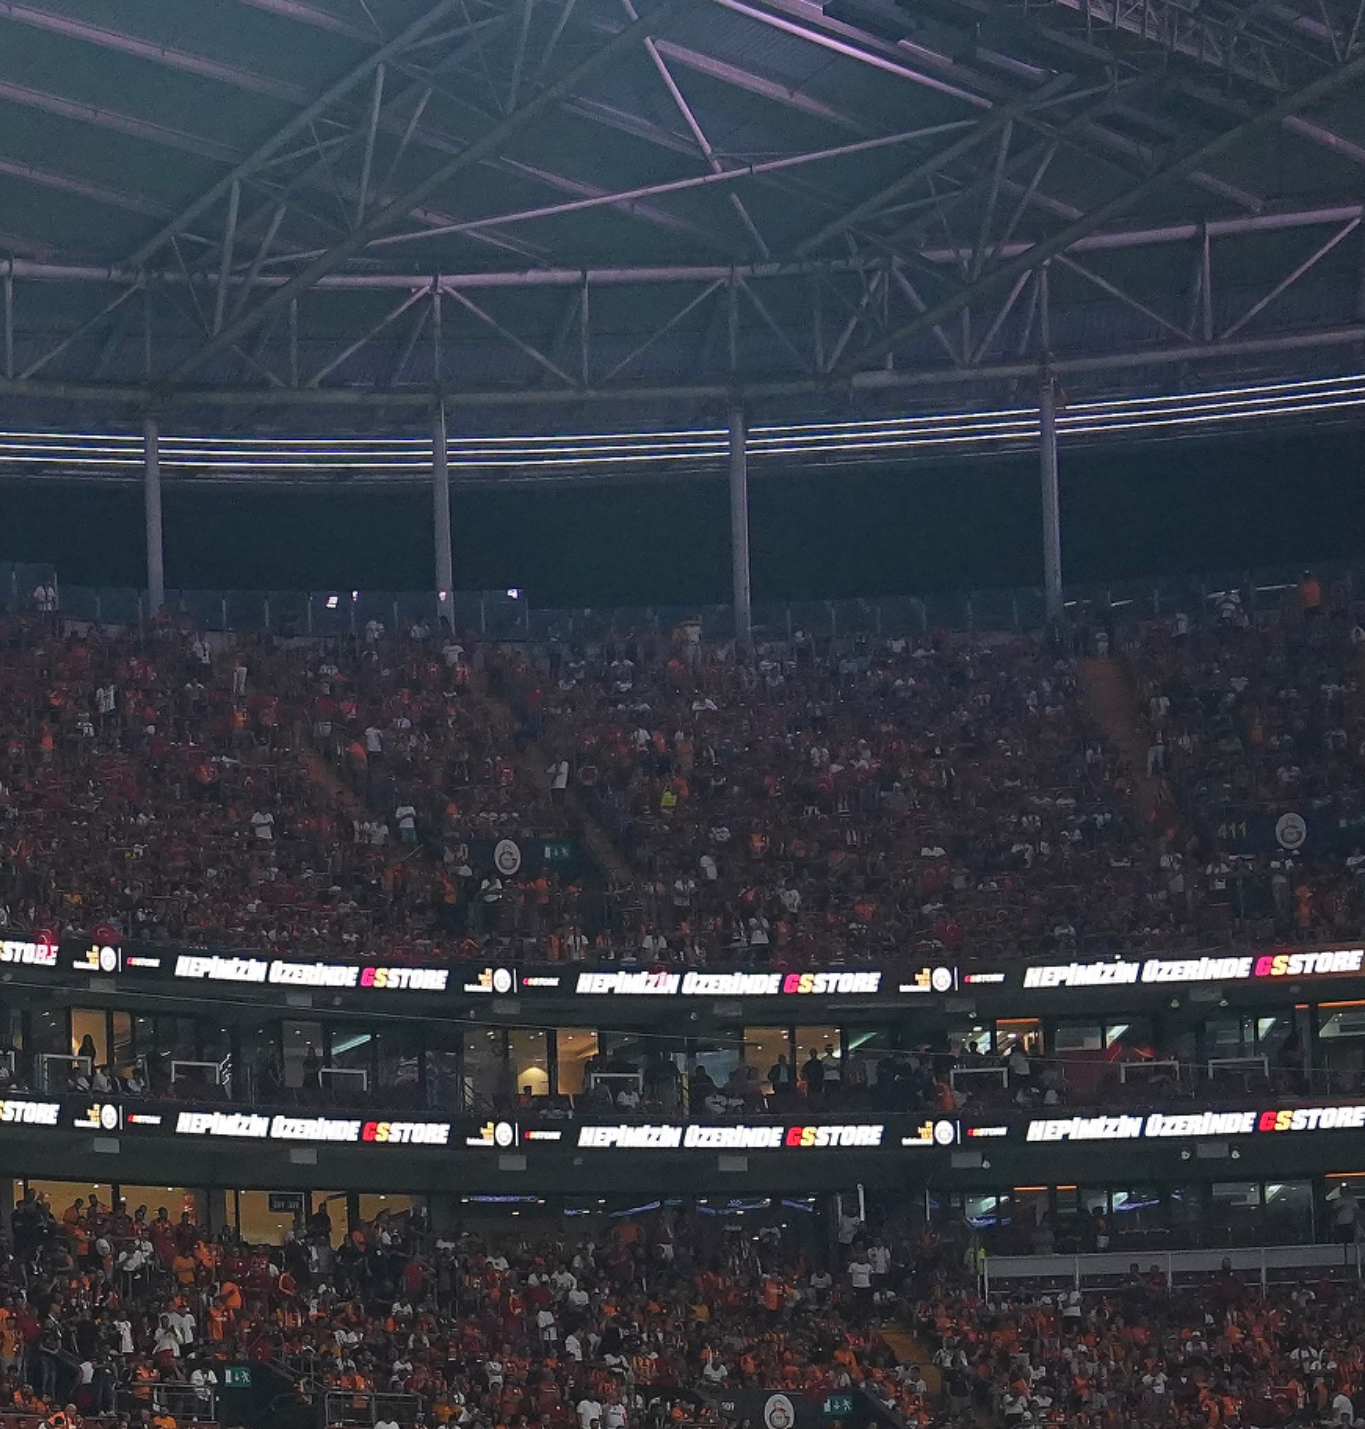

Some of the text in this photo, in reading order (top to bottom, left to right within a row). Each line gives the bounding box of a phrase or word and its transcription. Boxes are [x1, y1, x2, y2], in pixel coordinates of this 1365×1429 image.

[269, 960, 360, 988] ÜZERİNDE
[360, 967, 449, 991] GSSTORE
[575, 971, 681, 995] HEPİMİZİN
[681, 971, 782, 995] ÜZERİNDE
[783, 972, 882, 994] GSSTORE
[1023, 950, 1365, 988] HEPİMİZİN ÜZERİNDE GSSTORE
[270, 1115, 362, 1142] ÜZERİNDE
[362, 1121, 451, 1144] GSSTORE
[577, 1124, 683, 1147] HEPİMİZİN
[683, 1124, 784, 1148] ÜZERİNDE
[785, 1125, 884, 1147] GSSTORE
[1026, 1114, 1144, 1142] HEPİMİZİN
[1144, 1112, 1259, 1137] ÜZERİNDE
